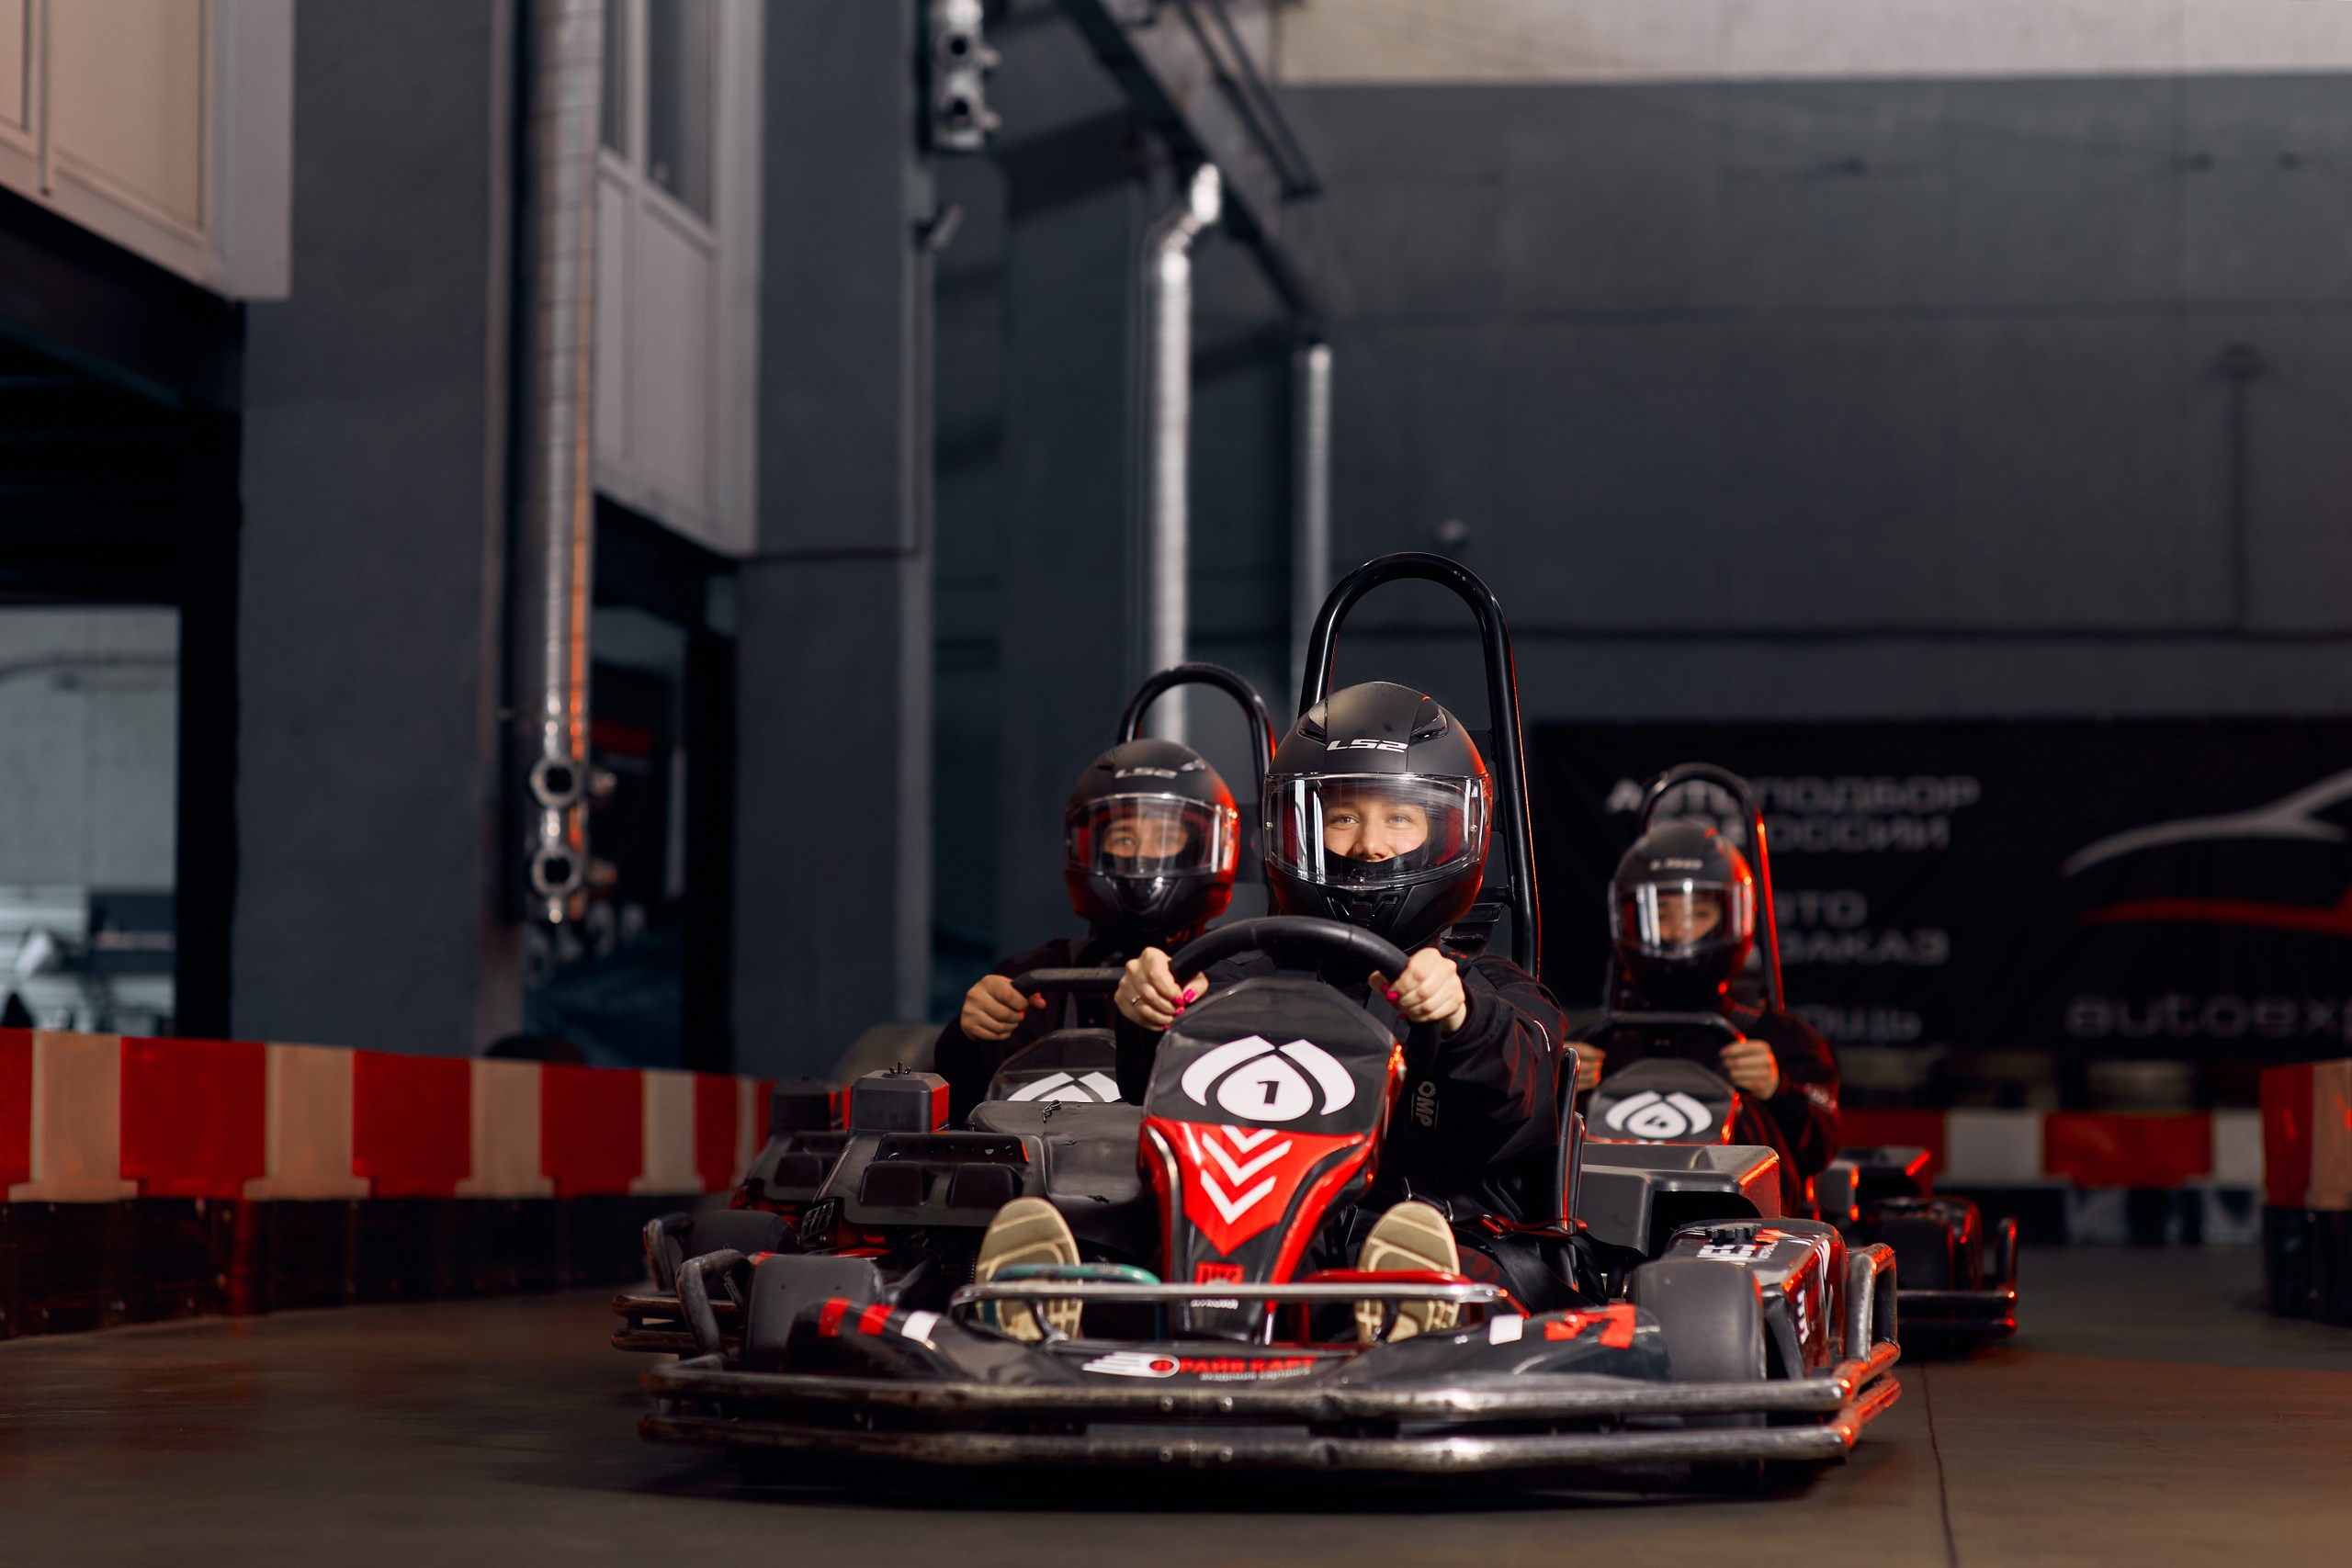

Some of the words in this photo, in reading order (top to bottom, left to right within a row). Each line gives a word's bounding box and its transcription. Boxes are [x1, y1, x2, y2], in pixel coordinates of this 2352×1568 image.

[1327, 739, 1408, 753] LS2
[2064, 990, 2352, 1047] autoex
[1256, 1080, 1280, 1104] 1
[1415, 1080, 1436, 1127] OMP
